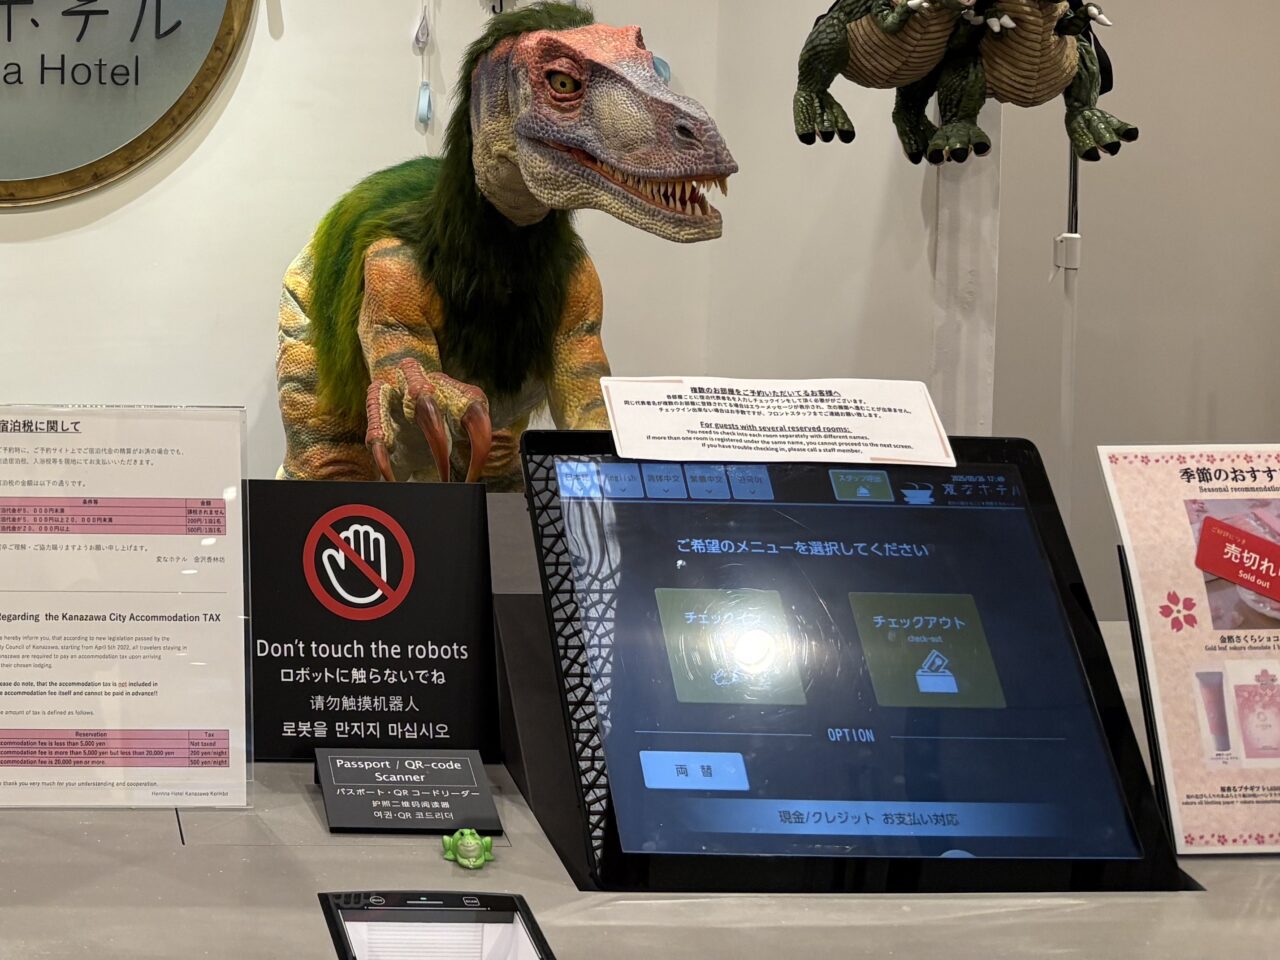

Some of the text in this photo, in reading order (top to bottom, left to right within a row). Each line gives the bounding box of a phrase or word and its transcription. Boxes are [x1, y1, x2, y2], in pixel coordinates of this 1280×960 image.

[40, 54, 139, 86] Hotel
[822, 426, 851, 435] rooms:
[1179, 467, 1280, 484] 季節のおすす
[678, 538, 928, 558] ご希望のメニューを選択してください
[1238, 569, 1270, 589] Sold out
[45, 612, 58, 621] the
[61, 613, 106, 621] Kanazawa
[109, 613, 126, 622] City
[129, 613, 199, 621] Accommodation
[202, 613, 220, 621] TAX
[873, 614, 966, 630] チェックアウト
[257, 639, 469, 660] Don't touch the robots
[280, 667, 446, 685] ロボットに触らないでね
[310, 696, 420, 712] 请勿触摸机器人
[282, 721, 450, 739] 로봇을 만지지 마십시오
[827, 727, 875, 743] OPTION
[336, 759, 461, 770] Passport / QR-code
[375, 772, 425, 782] Scanner
[412, 789, 479, 797] コードリーダー
[372, 800, 450, 809] 护照二维码阅读器
[415, 811, 454, 820] 코드리더
[779, 810, 958, 827] 現金/クレジット お支払い対応
